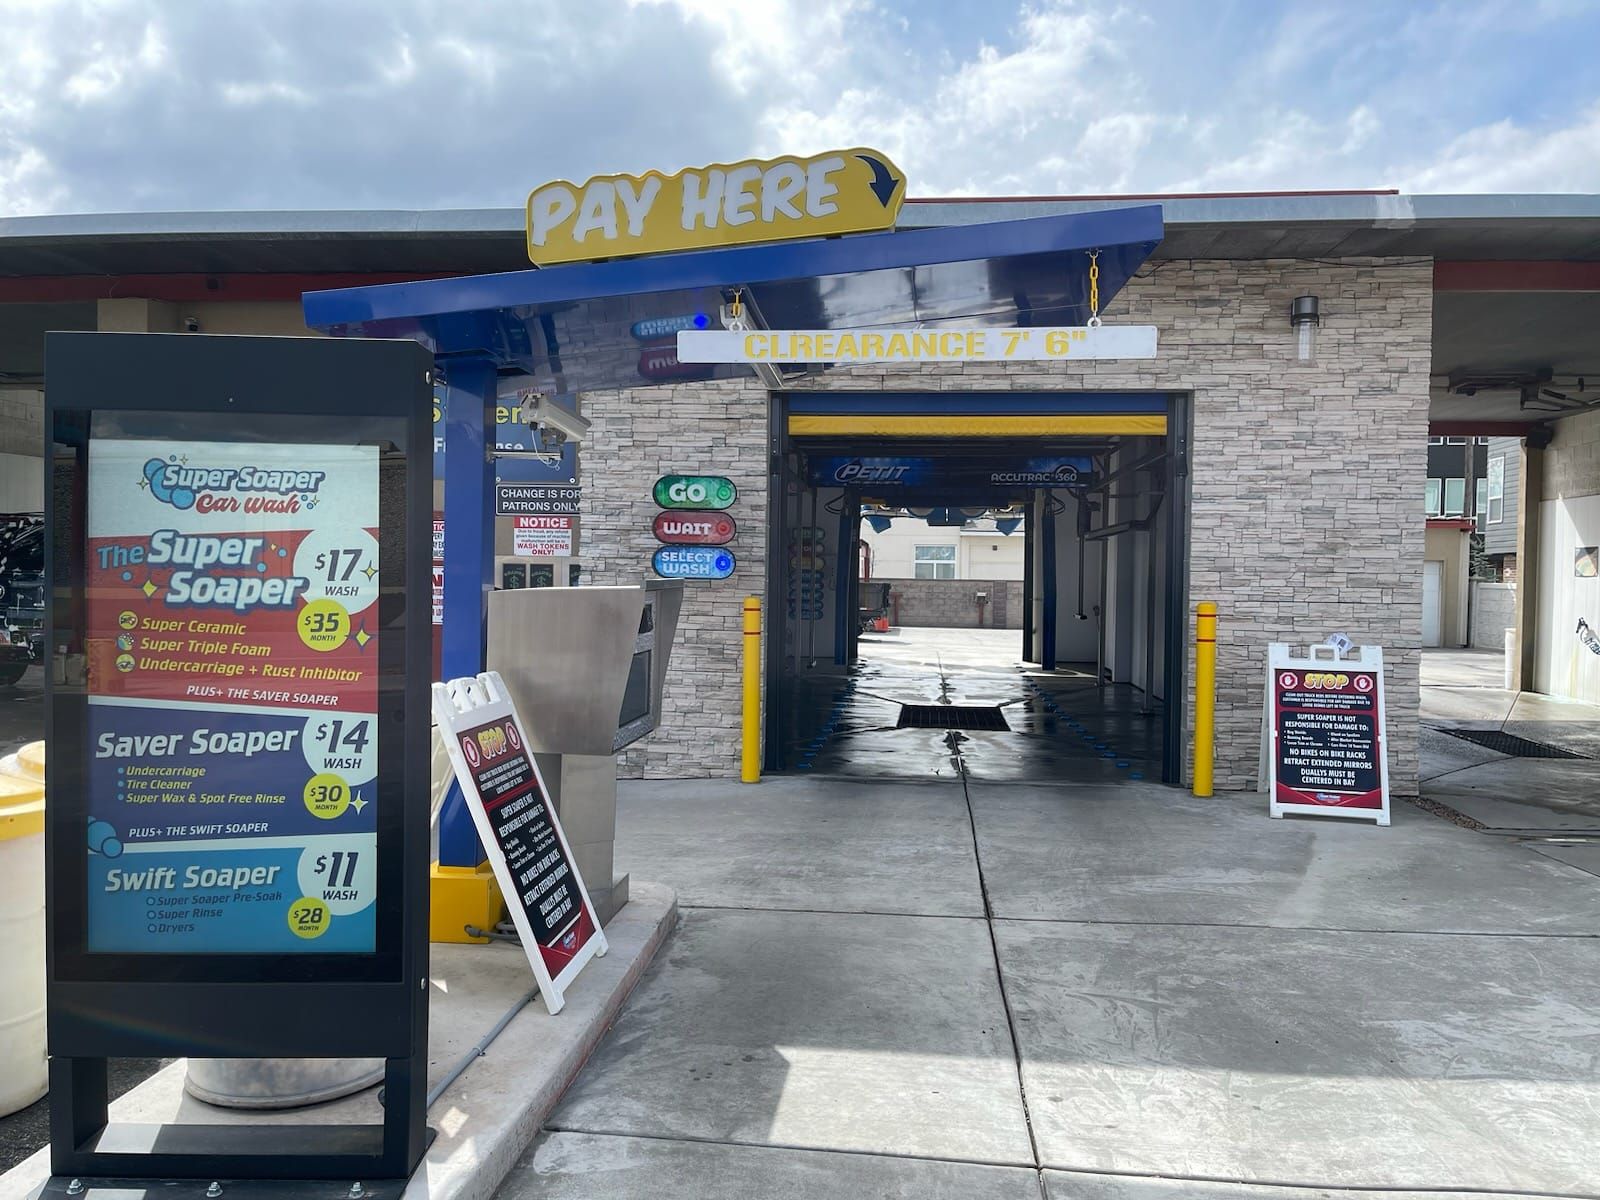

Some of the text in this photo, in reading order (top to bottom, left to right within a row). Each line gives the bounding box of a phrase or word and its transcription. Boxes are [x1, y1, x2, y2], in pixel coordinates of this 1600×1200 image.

[530, 157, 847, 248] PAY HERE
[744, 331, 1088, 360] CLREARANCE 7' 6"
[162, 465, 325, 492] Super Soaper
[837, 464, 910, 480] PETIT
[991, 472, 1077, 481] ACCUTRAC 360
[501, 489, 582, 499] CHANGE IS FOR
[669, 483, 706, 503] GO
[195, 493, 301, 513] Car Wash
[502, 501, 581, 511] PATRONS ONLY
[519, 518, 568, 528] NOTICE
[663, 522, 712, 535] WAIT
[98, 530, 263, 569] The Super
[661, 551, 713, 563] SELECT
[315, 549, 363, 582] $17
[663, 563, 710, 575] WASH
[166, 571, 306, 610] Soaper
[324, 585, 359, 597] WASH
[141, 617, 246, 635] Super Ceramic
[304, 612, 340, 632] $35
[310, 634, 336, 643] MONTH
[140, 637, 271, 657] Super Triple Foam
[139, 657, 244, 677] Undercarriage
[262, 664, 296, 679] Rust
[300, 666, 362, 682] Inhibitor
[1304, 673, 1349, 689] STOP
[186, 685, 338, 706] PLUS+ THE SAVER SOAPER
[95, 729, 299, 759] Saver Soaper
[315, 719, 369, 754] $14
[478, 726, 507, 760] STOP
[1320, 749, 1329, 757] ON
[1346, 751, 1366, 759] RACKS
[323, 758, 361, 769] WASH
[1284, 757, 1372, 769] RETRACT EXTENDED MIRRORS
[126, 766, 205, 778] Undercarriage
[1301, 768, 1327, 776] DUALLYS
[1302, 776, 1332, 784] CENTERED
[126, 779, 192, 790] Tire Cleaner
[126, 792, 286, 805] Super Wax & Spot Free Rinse
[310, 785, 342, 802] $30
[129, 822, 268, 837] PLUS+ THE SWIFT SOAPER
[314, 851, 359, 887] $11
[105, 865, 280, 892] Swift Soaper
[156, 891, 282, 908] Super Soaper Pre-Soak
[322, 890, 358, 901] WASH
[157, 907, 223, 921] Super Rinse
[293, 908, 323, 924] $28
[158, 922, 195, 935] Dryers
